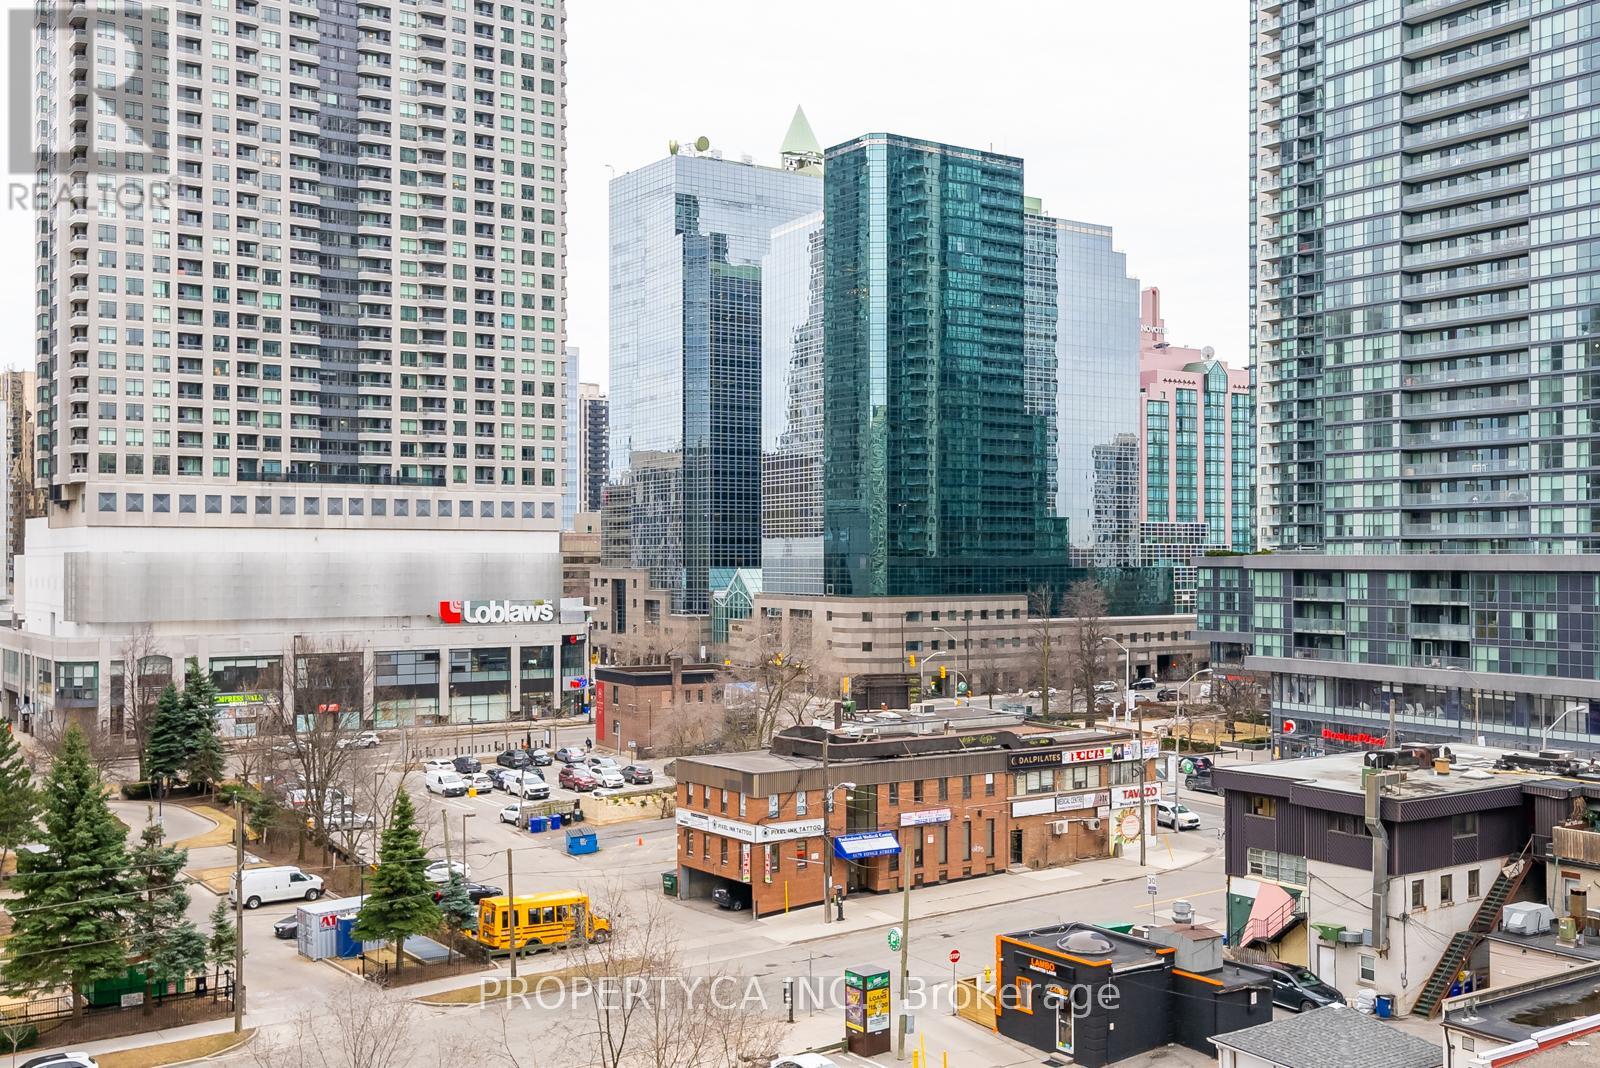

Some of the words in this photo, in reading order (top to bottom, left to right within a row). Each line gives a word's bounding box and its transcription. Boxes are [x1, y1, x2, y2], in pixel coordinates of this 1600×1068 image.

[464, 600, 554, 623] Loblaws
[1019, 753, 1061, 765] DALPILATES
[1122, 786, 1157, 800] TAVZO
[771, 828, 787, 836] PIXEL
[800, 824, 823, 832] TATTOO
[1030, 957, 1056, 971] LAMBO
